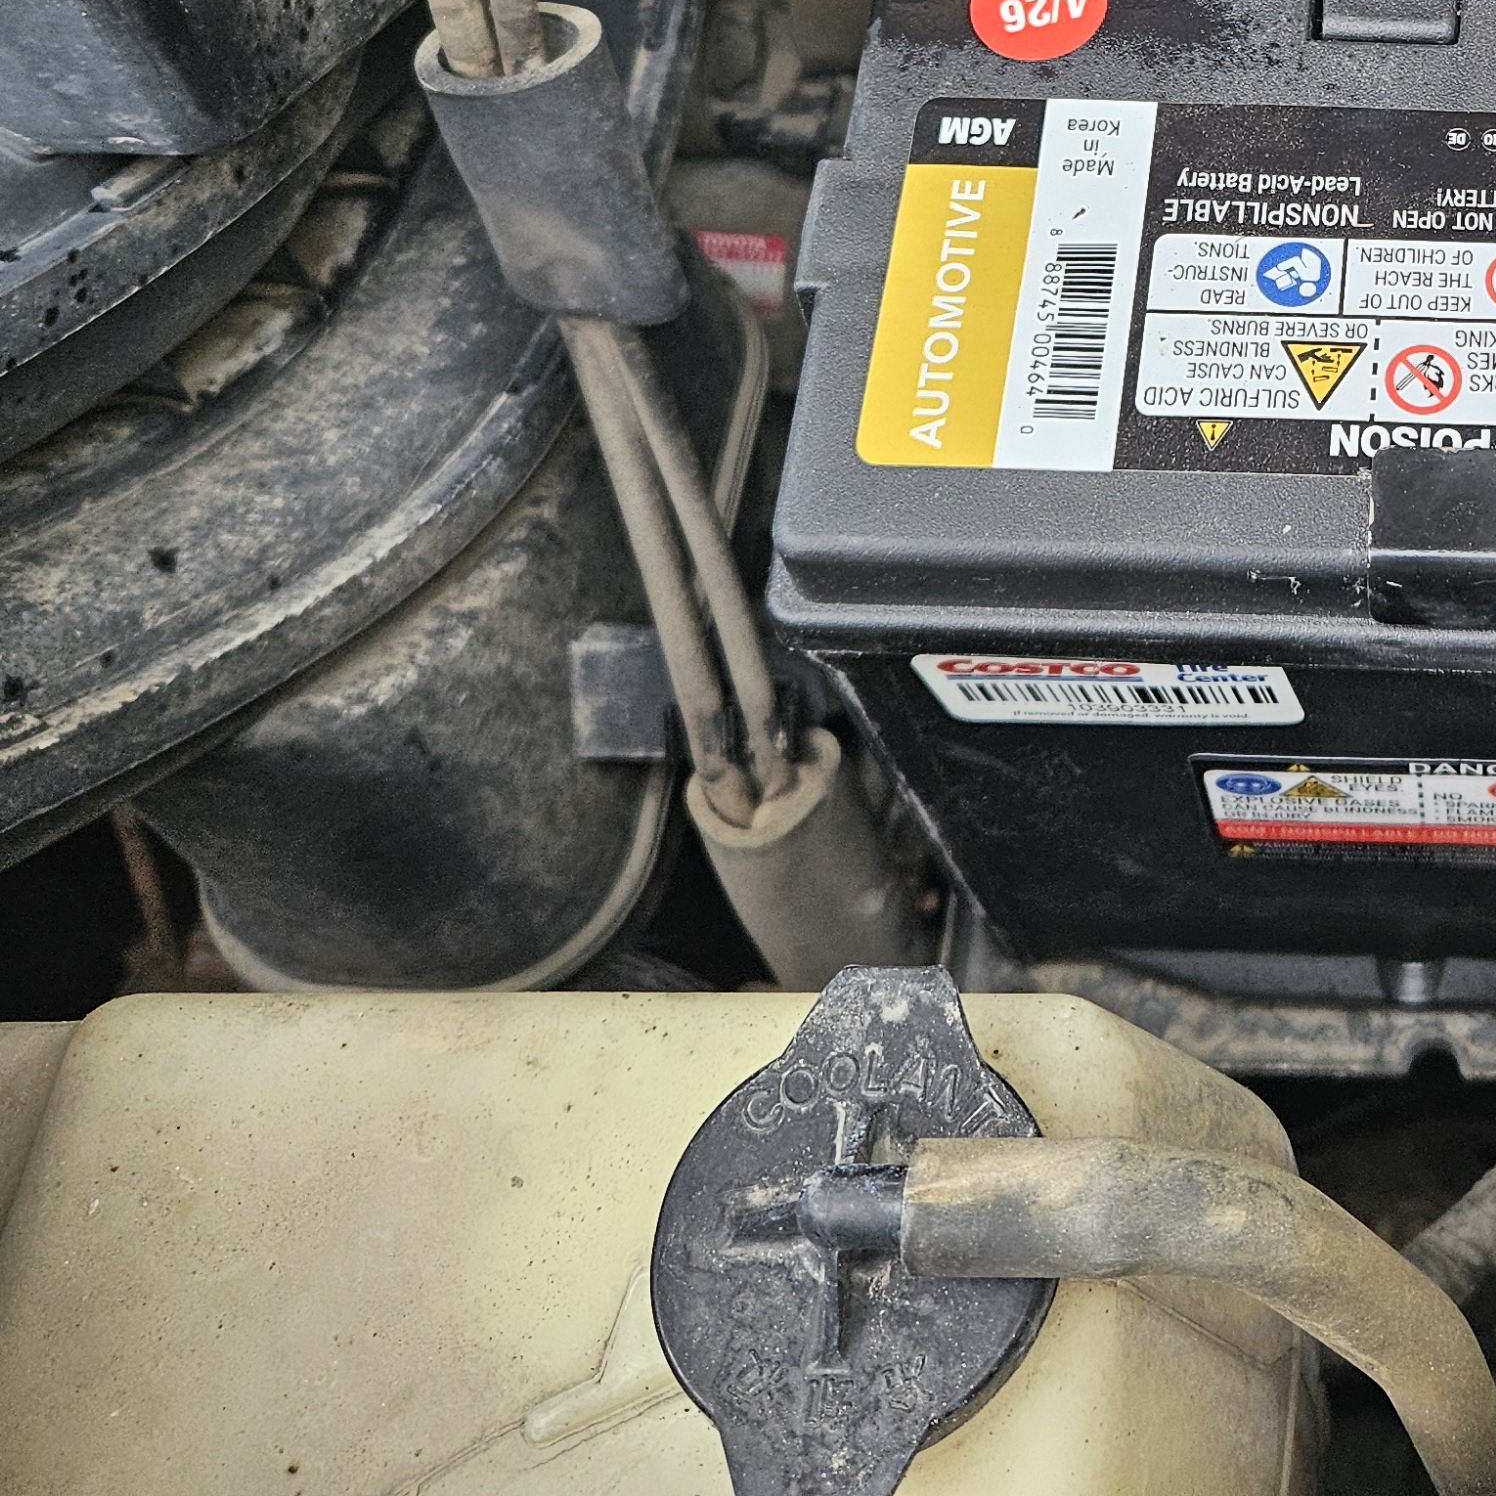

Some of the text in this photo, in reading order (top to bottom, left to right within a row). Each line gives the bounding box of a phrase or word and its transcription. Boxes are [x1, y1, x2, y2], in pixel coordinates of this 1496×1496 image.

[939, 117, 1016, 145] AGM
[1068, 119, 1120, 135] Korea
[1084, 140, 1099, 155] in
[1063, 159, 1114, 176] Made
[1177, 167, 1361, 196] Lead-Acid Battery
[1162, 199, 1360, 228] NONSPILLABLE
[1393, 210, 1445, 229] OPEN
[1452, 212, 1493, 231] NOT
[1194, 242, 1249, 259] TIONS.
[1356, 248, 1473, 265] OF CHILDREN.
[1167, 265, 1248, 281] INSTRUC-
[1375, 271, 1472, 288] THE REACH
[1036, 262, 1062, 322] 88745
[1201, 289, 1245, 304] READ
[1359, 294, 1471, 312] KEEP OUT OF
[910, 180, 985, 448] AUTOMOTIVE
[1208, 320, 1368, 338] OR SEVERE BURNS.
[1173, 340, 1269, 357] BLINDNESS
[1025, 333, 1051, 397] 00464
[1187, 363, 1286, 380] CAN CAUSE
[1144, 387, 1300, 409] SULFURIC ACID
[1021, 426, 1034, 434] 0
[937, 658, 1141, 677] COSTCO
[1177, 673, 1269, 683] Center
[742, 1044, 1011, 1138] COOLANT
